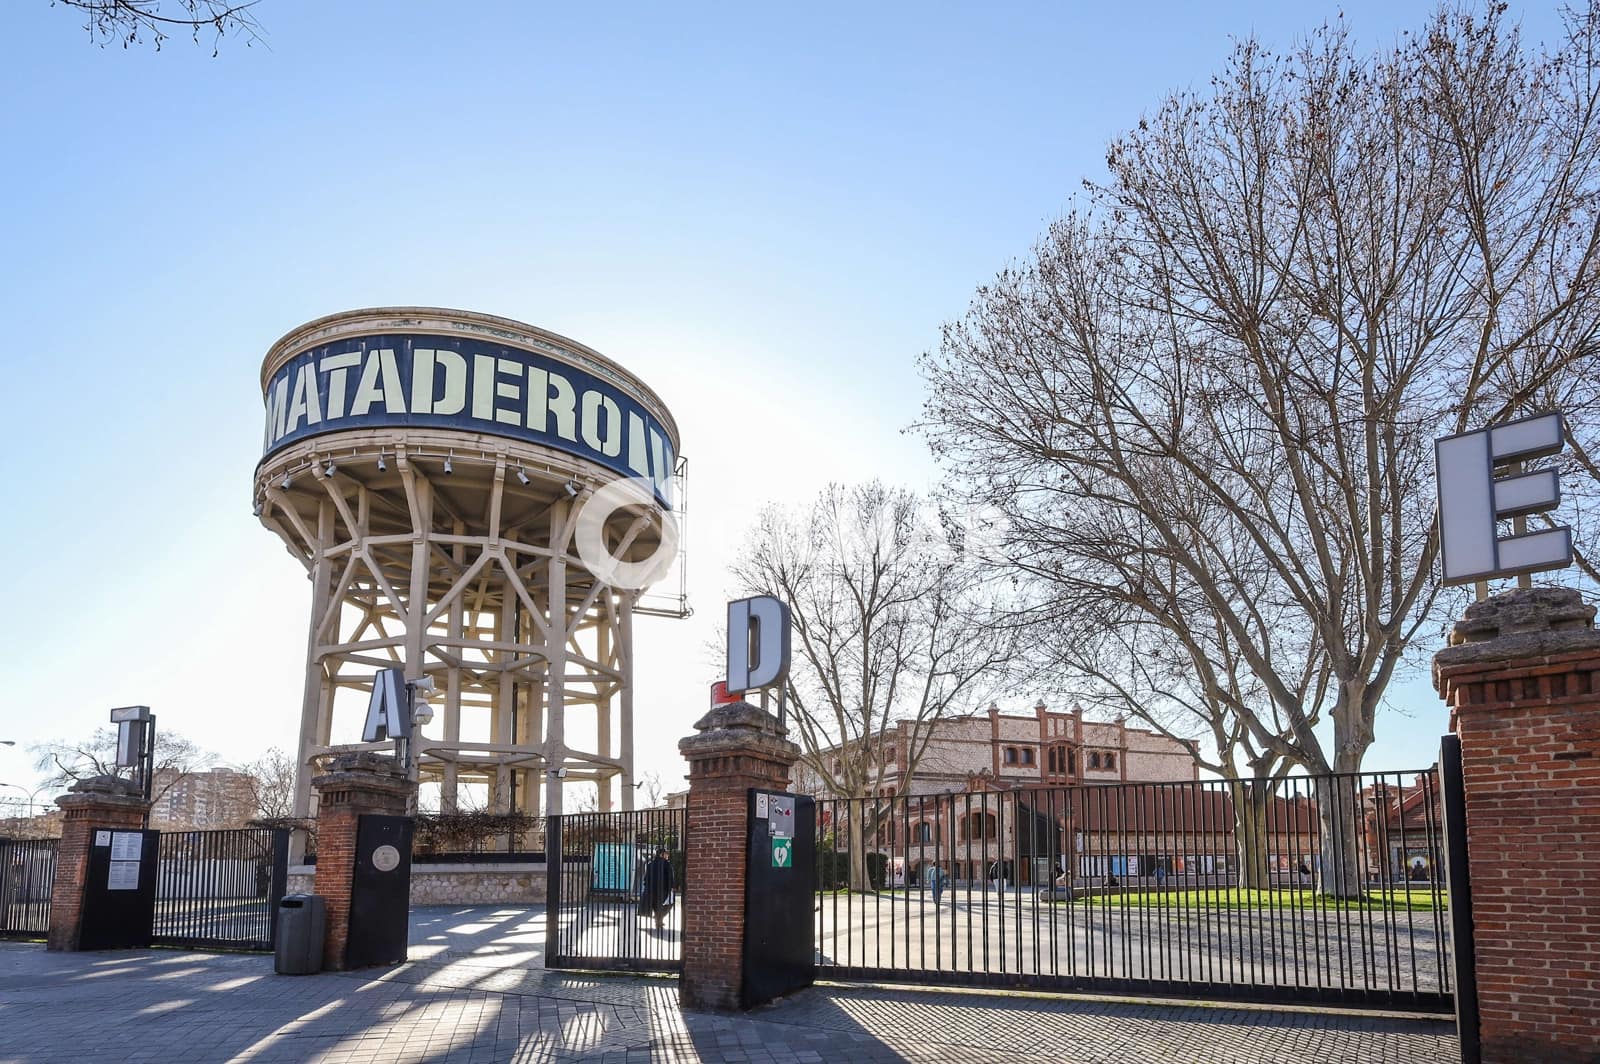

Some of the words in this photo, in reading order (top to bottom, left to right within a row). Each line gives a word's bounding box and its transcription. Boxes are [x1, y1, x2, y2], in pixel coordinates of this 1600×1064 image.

[264, 348, 621, 457] MATADERO
[361, 668, 408, 742] A
[727, 595, 791, 693] D
[1434, 411, 1572, 586] E
